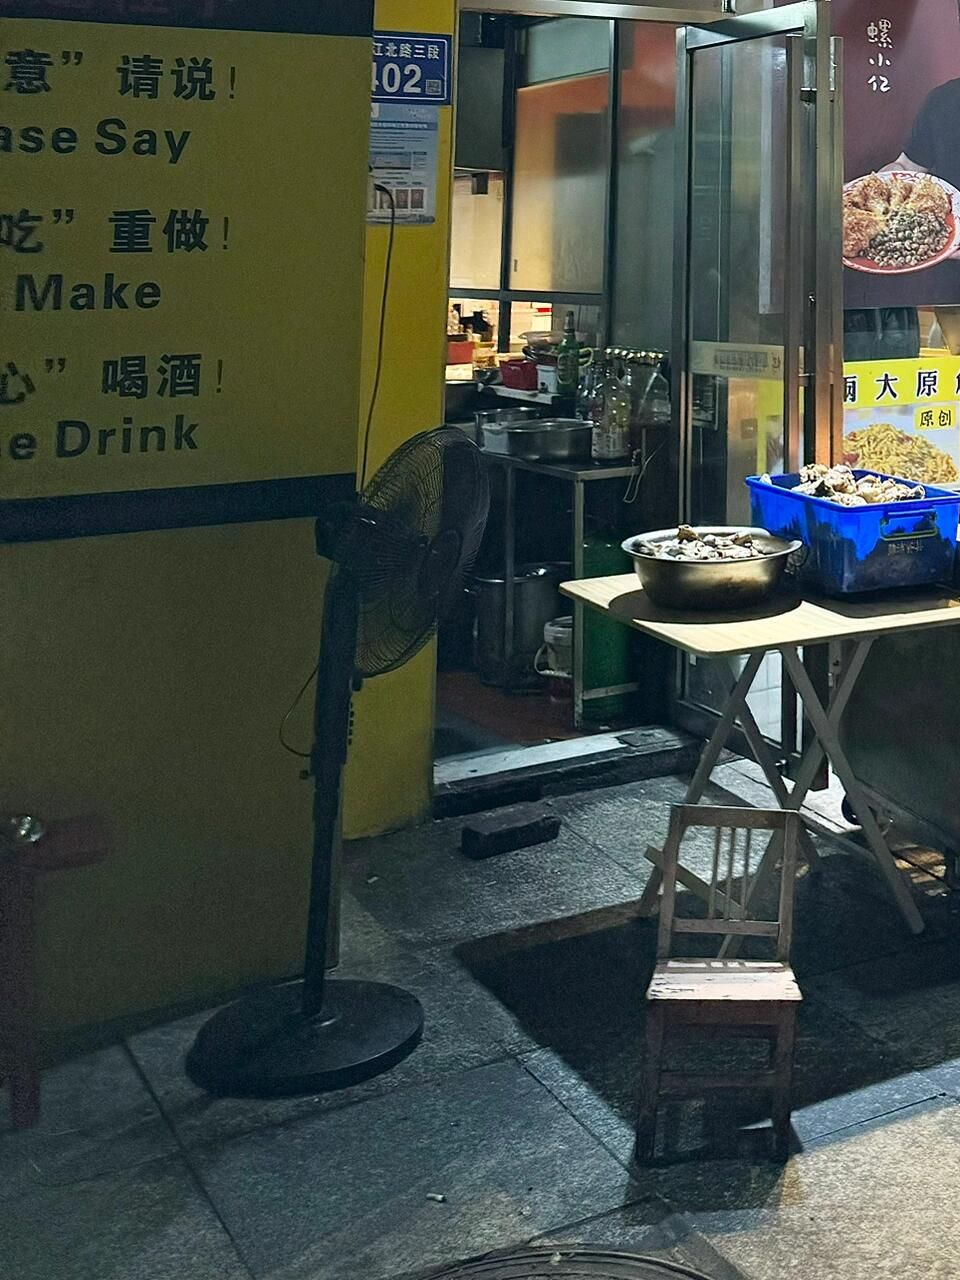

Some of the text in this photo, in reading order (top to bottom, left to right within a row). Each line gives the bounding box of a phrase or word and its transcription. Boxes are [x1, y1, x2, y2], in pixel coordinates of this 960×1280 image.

[866, 18, 893, 93] 螺小亿
[94, 117, 192, 165] Say
[15, 272, 161, 312] Make
[56, 413, 200, 459] Drink
[919, 409, 951, 428] 原创
